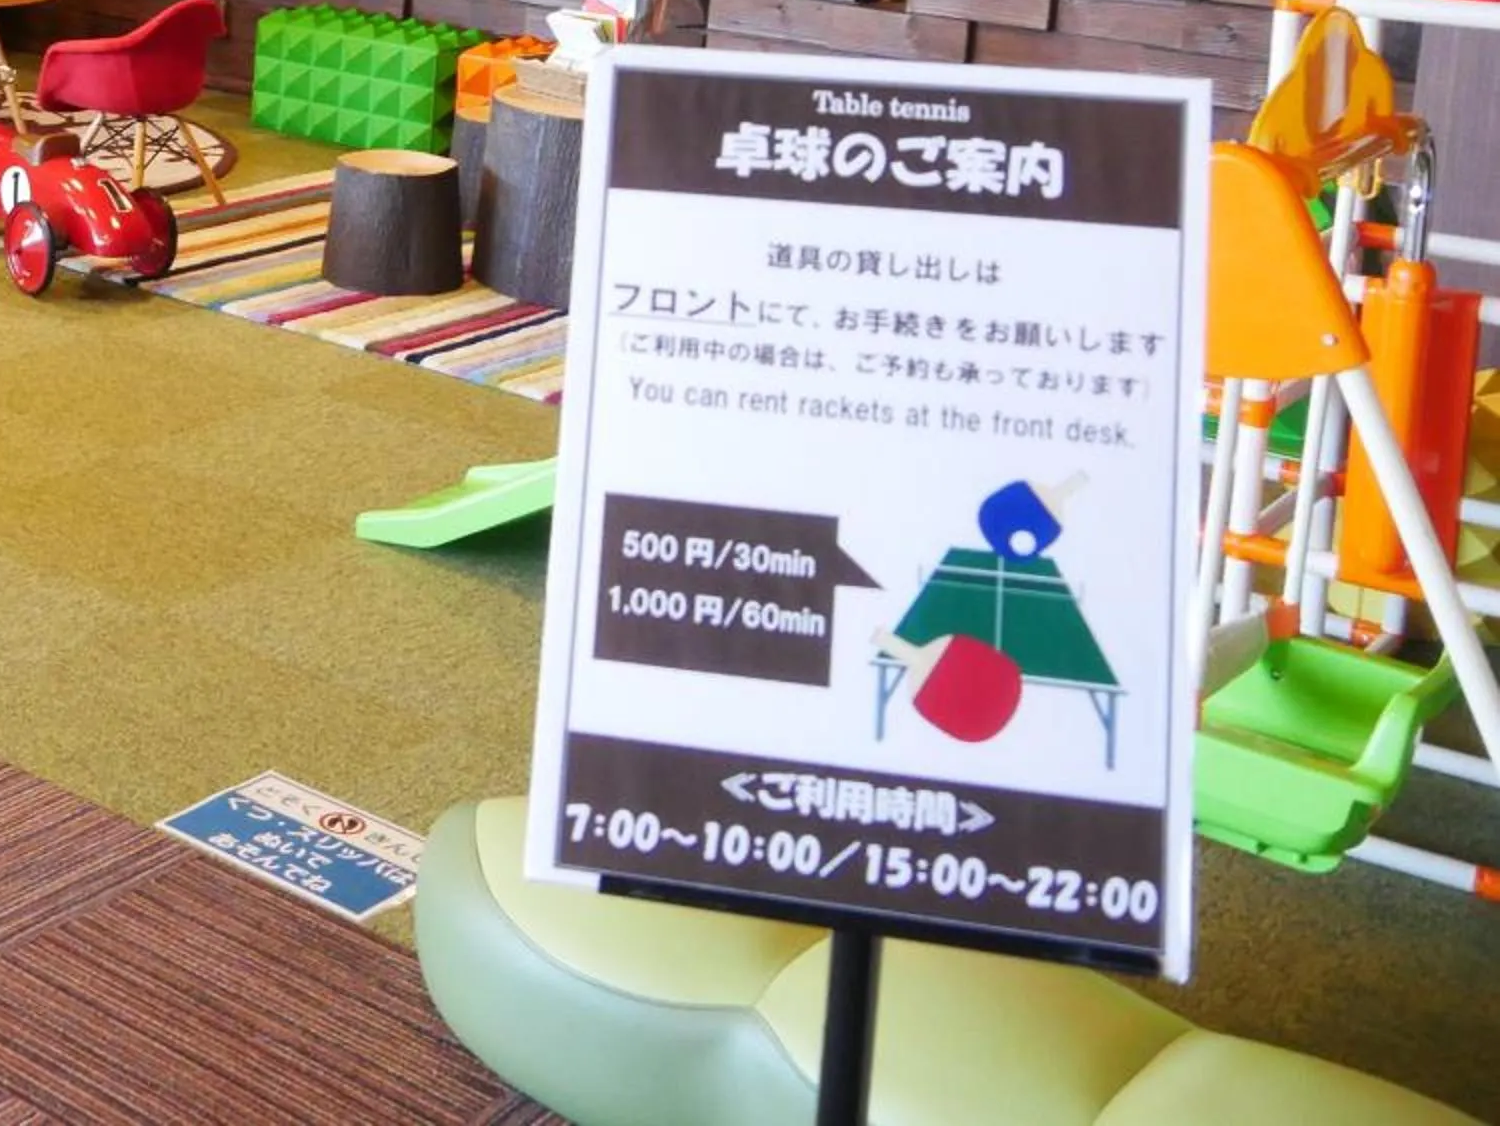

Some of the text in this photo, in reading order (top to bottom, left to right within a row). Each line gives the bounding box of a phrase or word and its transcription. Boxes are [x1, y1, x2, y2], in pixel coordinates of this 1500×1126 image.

[813, 90, 971, 123] Table tennis
[715, 121, 1065, 199] 卓球のご案内
[767, 241, 1002, 285] 道具の貸し出しは
[629, 376, 1136, 449] You can rent rackets at the front desk.
[622, 529, 678, 563] 500
[208, 831, 333, 893] あそんでね
[253, 831, 334, 869] ぬいで
